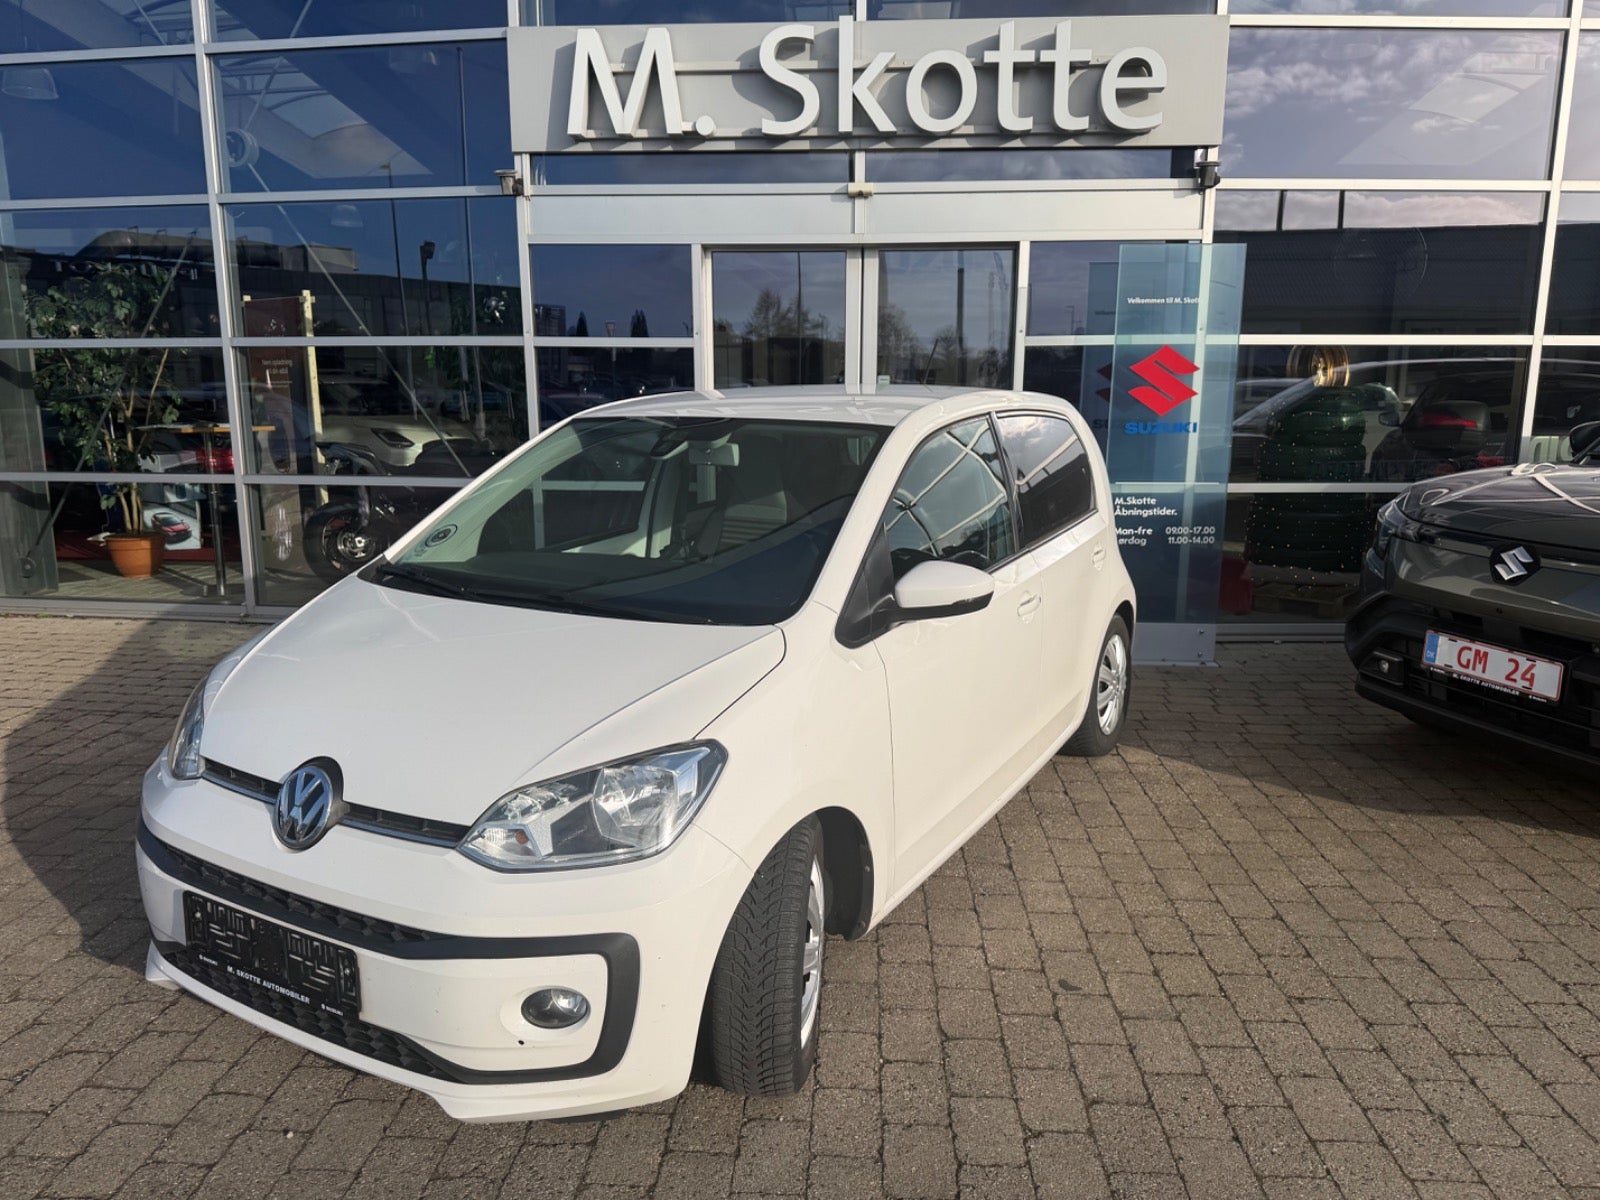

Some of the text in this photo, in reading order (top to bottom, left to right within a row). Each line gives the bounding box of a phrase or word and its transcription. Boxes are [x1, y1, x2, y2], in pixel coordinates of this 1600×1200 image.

[567, 15, 1169, 139] M. Skotte
[1127, 296, 1165, 304] Velkommen
[1124, 421, 1198, 435] SUZUKI
[1114, 506, 1178, 517] Åbningstider.
[1116, 536, 1215, 546] ørdag 11.00-14.00
[1456, 645, 1538, 689] GM 24
[226, 964, 311, 1004] M. SKOTTE AUTOMOBILER
